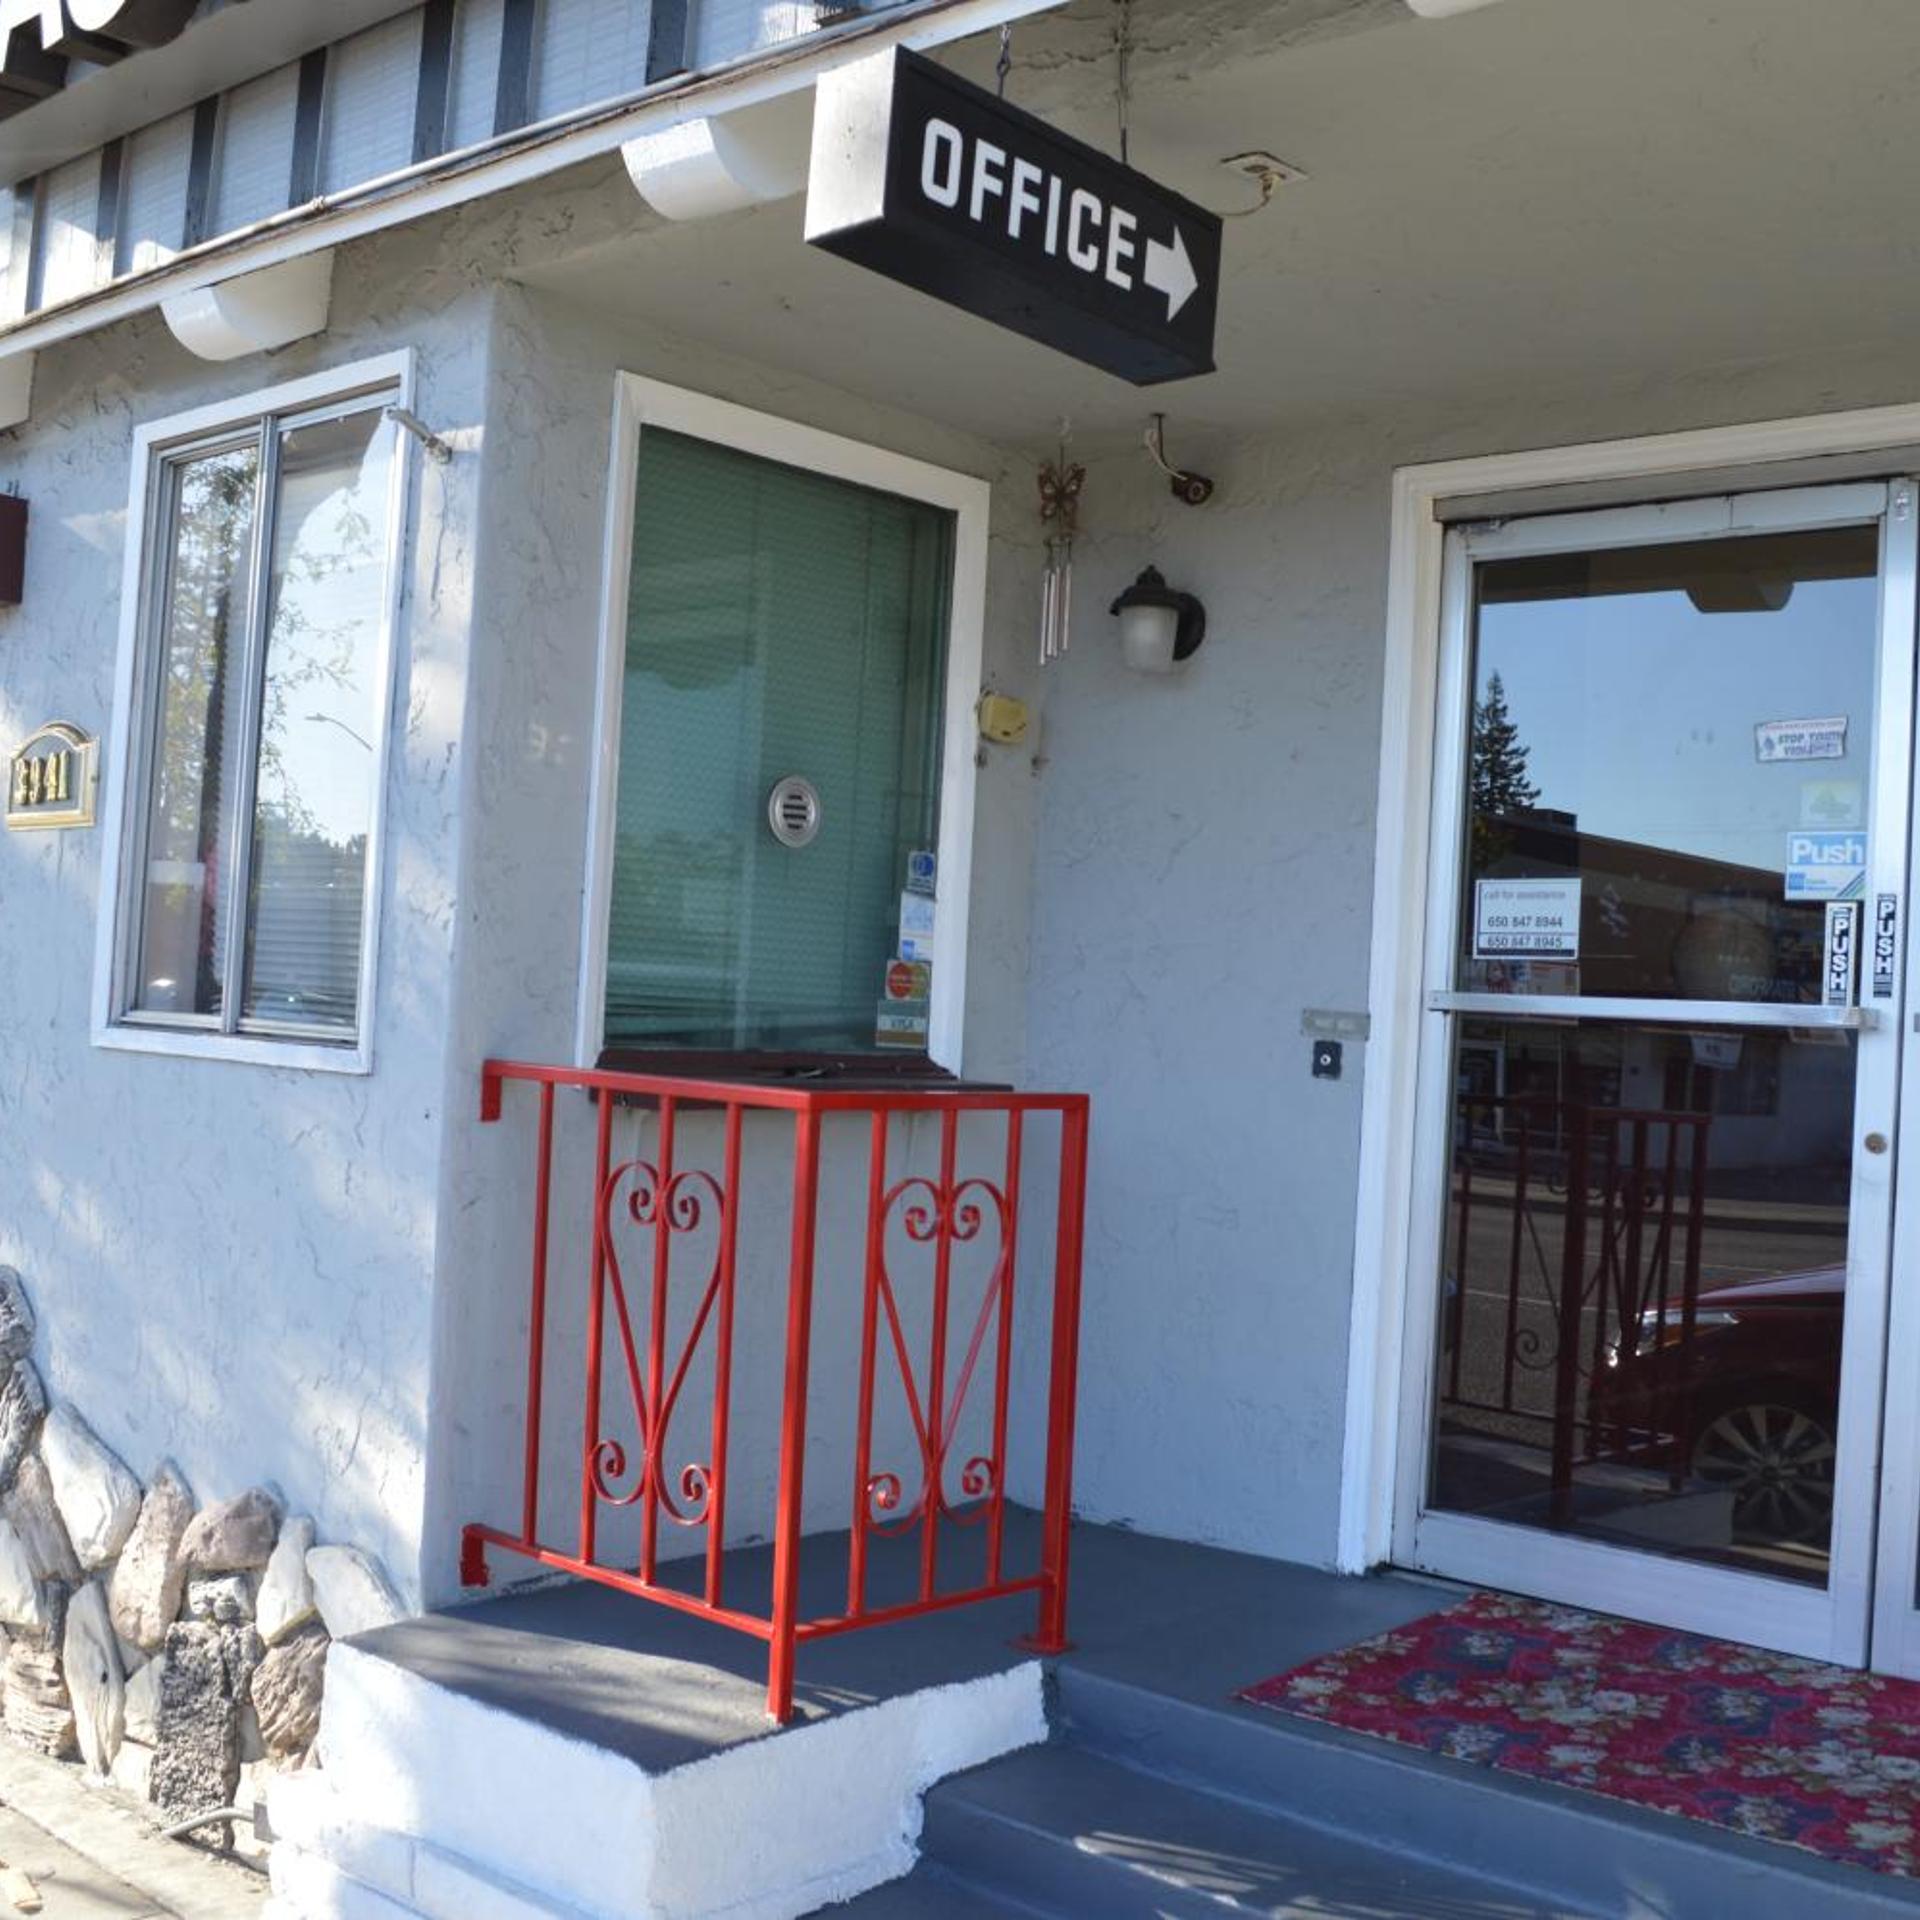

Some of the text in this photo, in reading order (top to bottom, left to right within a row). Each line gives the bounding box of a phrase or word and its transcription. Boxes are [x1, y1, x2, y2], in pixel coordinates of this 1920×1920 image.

[921, 117, 1137, 291] OFFICE
[1791, 838, 1865, 864] Push
[1487, 916, 1508, 928] 650
[1487, 936, 1508, 948] 650
[1876, 901, 1896, 974] PUSH
[1829, 917, 1849, 990] PUSH
